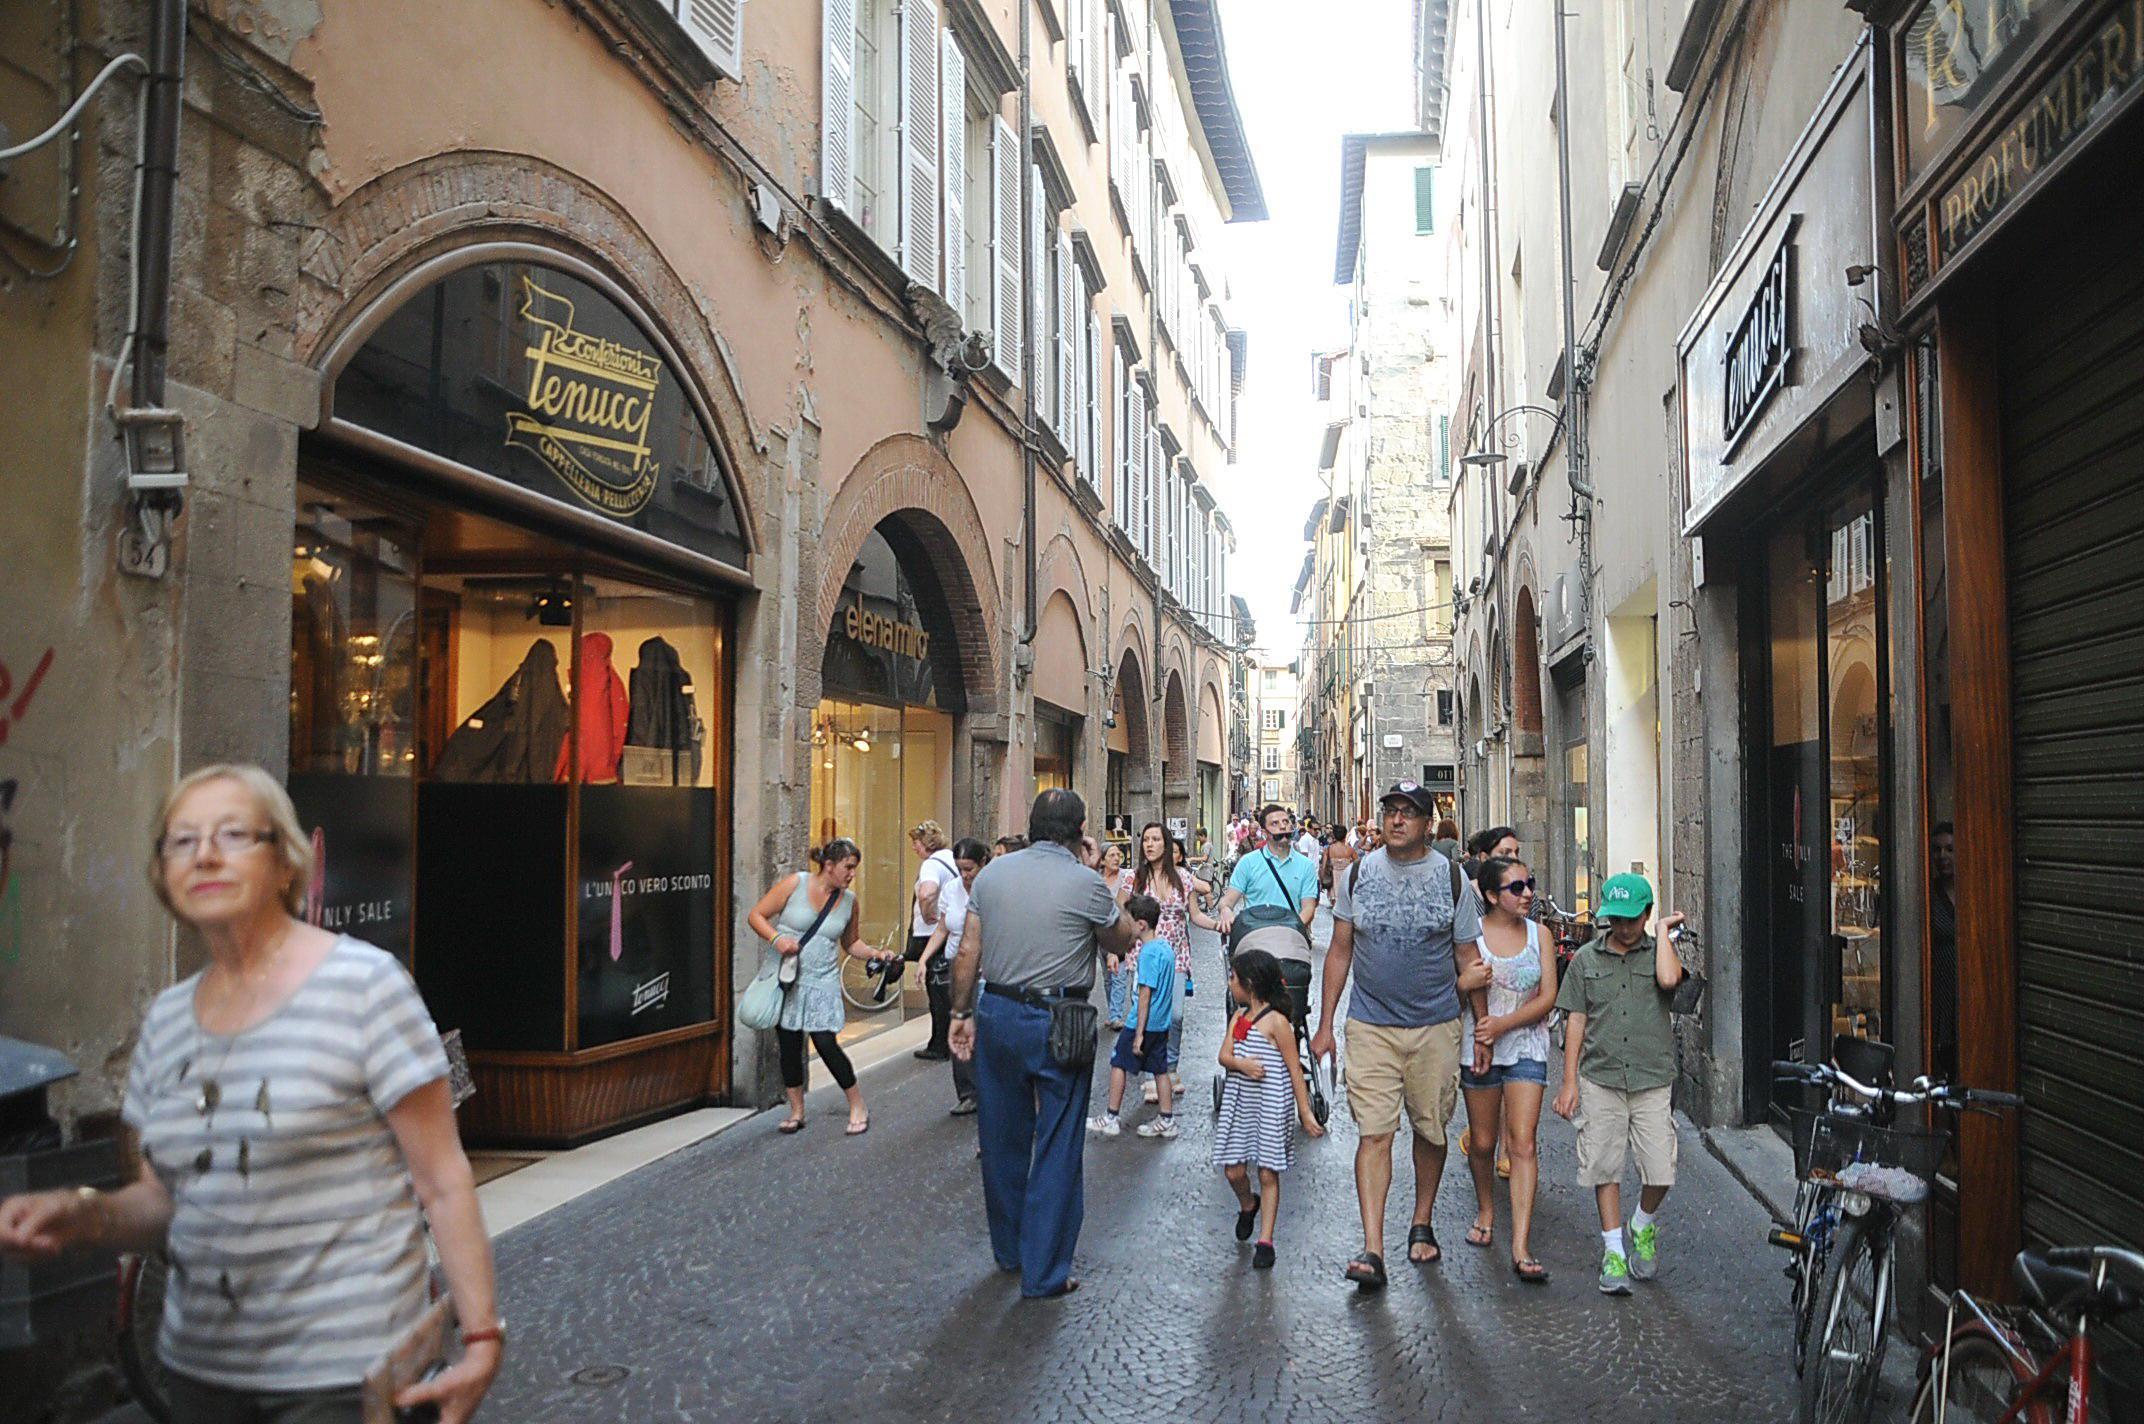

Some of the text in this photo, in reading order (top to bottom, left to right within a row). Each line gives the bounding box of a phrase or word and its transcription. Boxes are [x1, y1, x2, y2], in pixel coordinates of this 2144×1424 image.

[585, 874, 711, 898] L'UNCO VERO SCONTO
[359, 900, 392, 923] SALE
